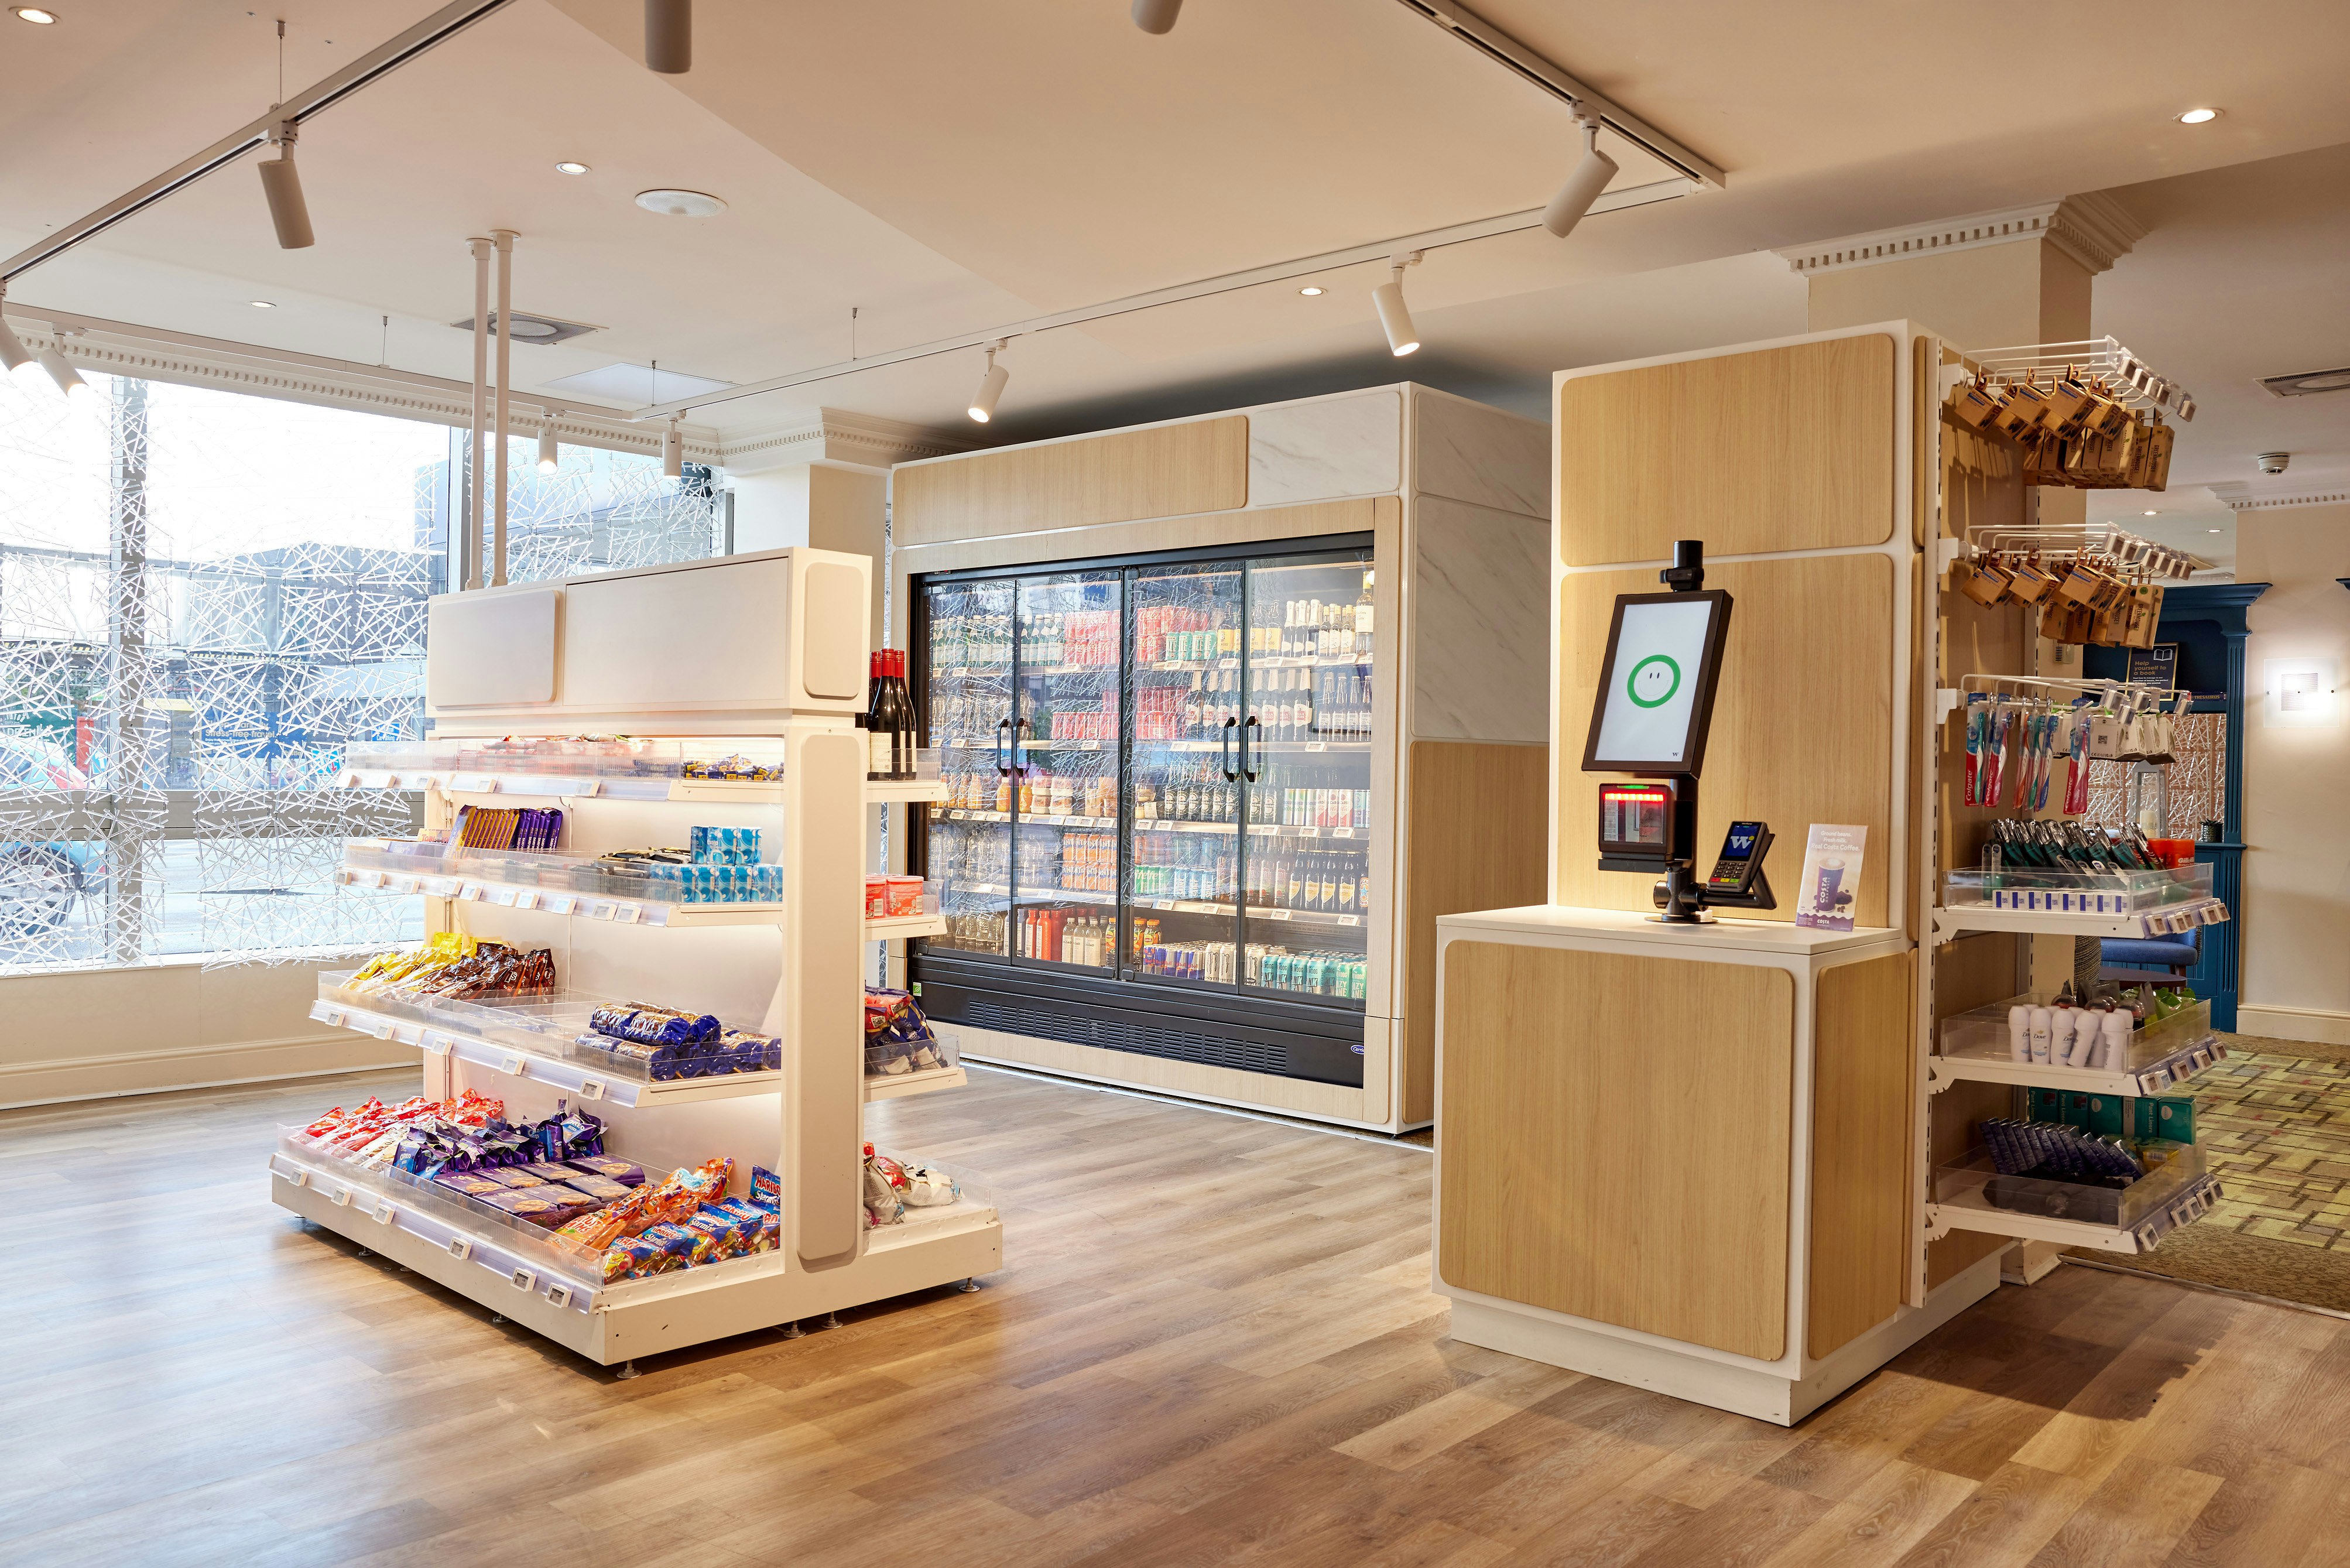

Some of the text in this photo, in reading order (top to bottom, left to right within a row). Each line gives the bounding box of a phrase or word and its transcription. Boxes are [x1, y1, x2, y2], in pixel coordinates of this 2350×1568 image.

[2151, 445, 2159, 472] GREENMOUSE
[567, 1119, 585, 1131] OREO
[400, 1153, 412, 1162] OREO
[755, 1175, 780, 1197] HARIBO
